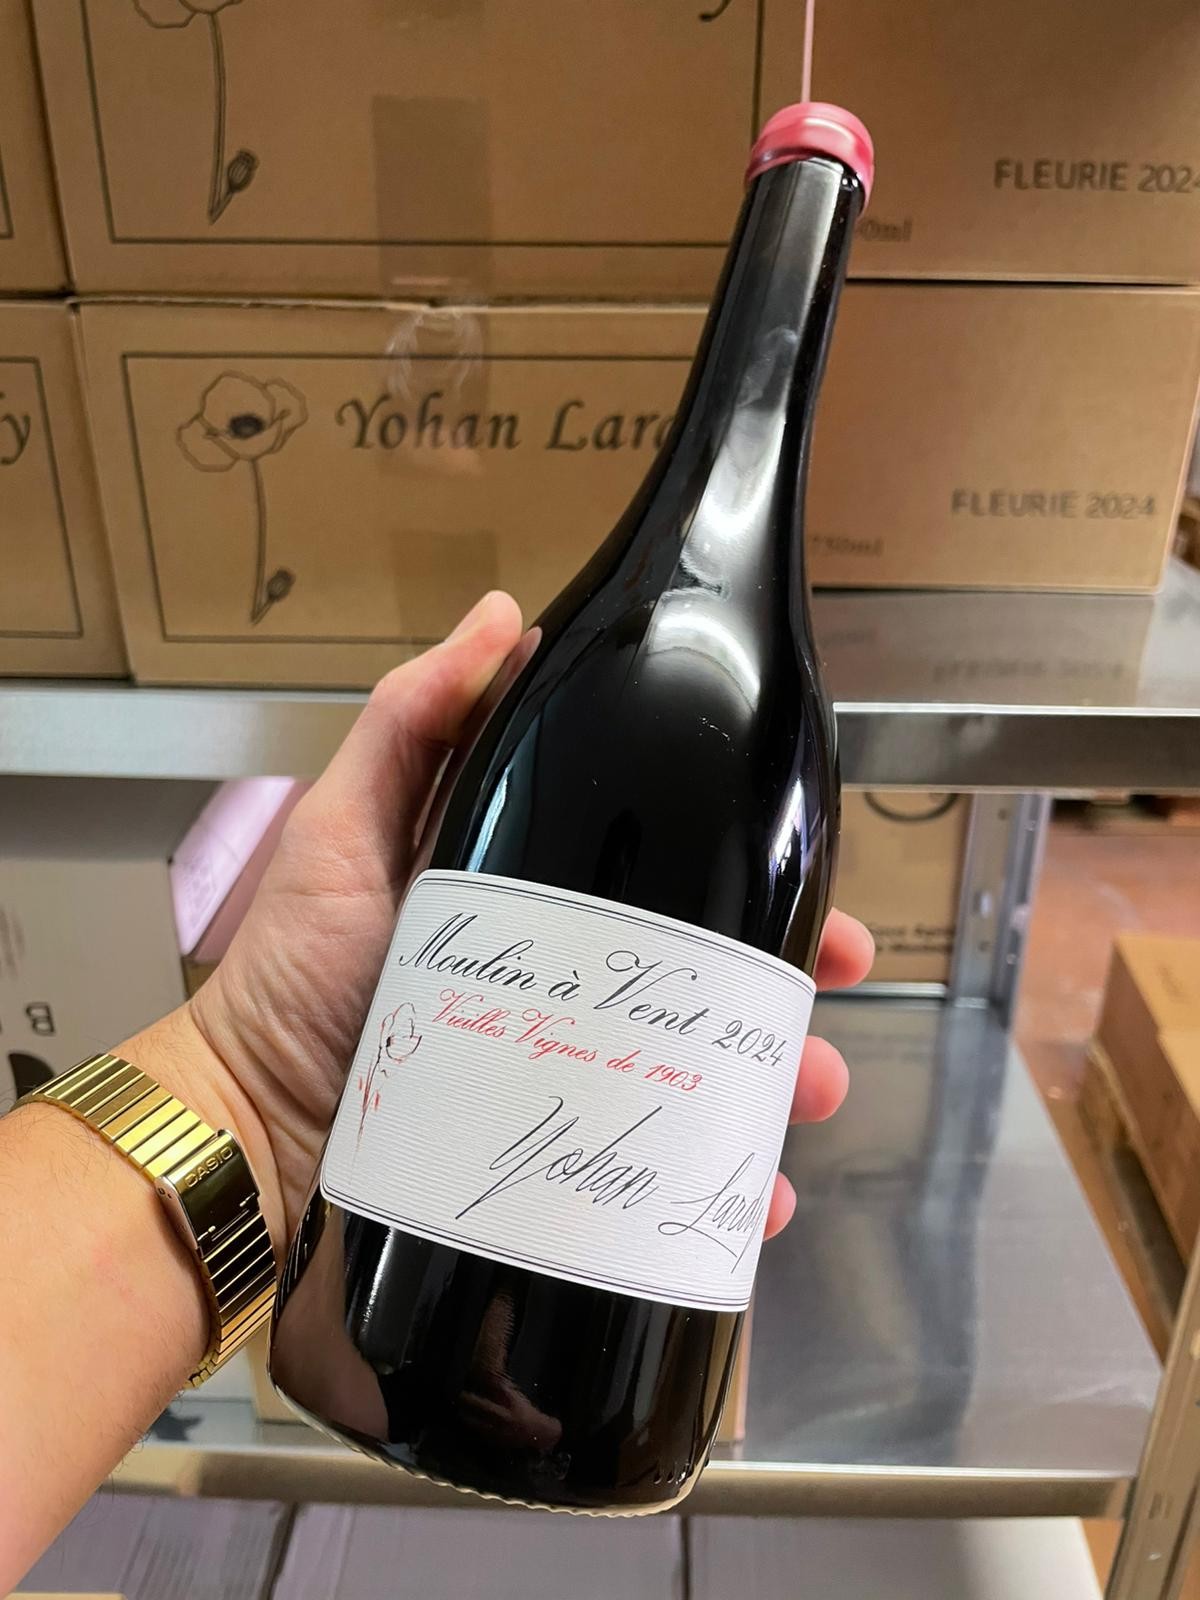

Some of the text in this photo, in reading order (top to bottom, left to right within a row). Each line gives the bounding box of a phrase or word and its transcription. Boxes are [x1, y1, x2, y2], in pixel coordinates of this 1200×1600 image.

[994, 159, 1128, 191] FLEURIE
[334, 390, 522, 450] Yohan
[952, 488, 1157, 519] FLEURIE 2024
[399, 912, 788, 1067] Moulin à Vent 2024
[432, 988, 703, 1092] Vieilles Vignes de 1903
[184, 1146, 233, 1188] CASIO
[455, 1095, 663, 1220] Yohan
